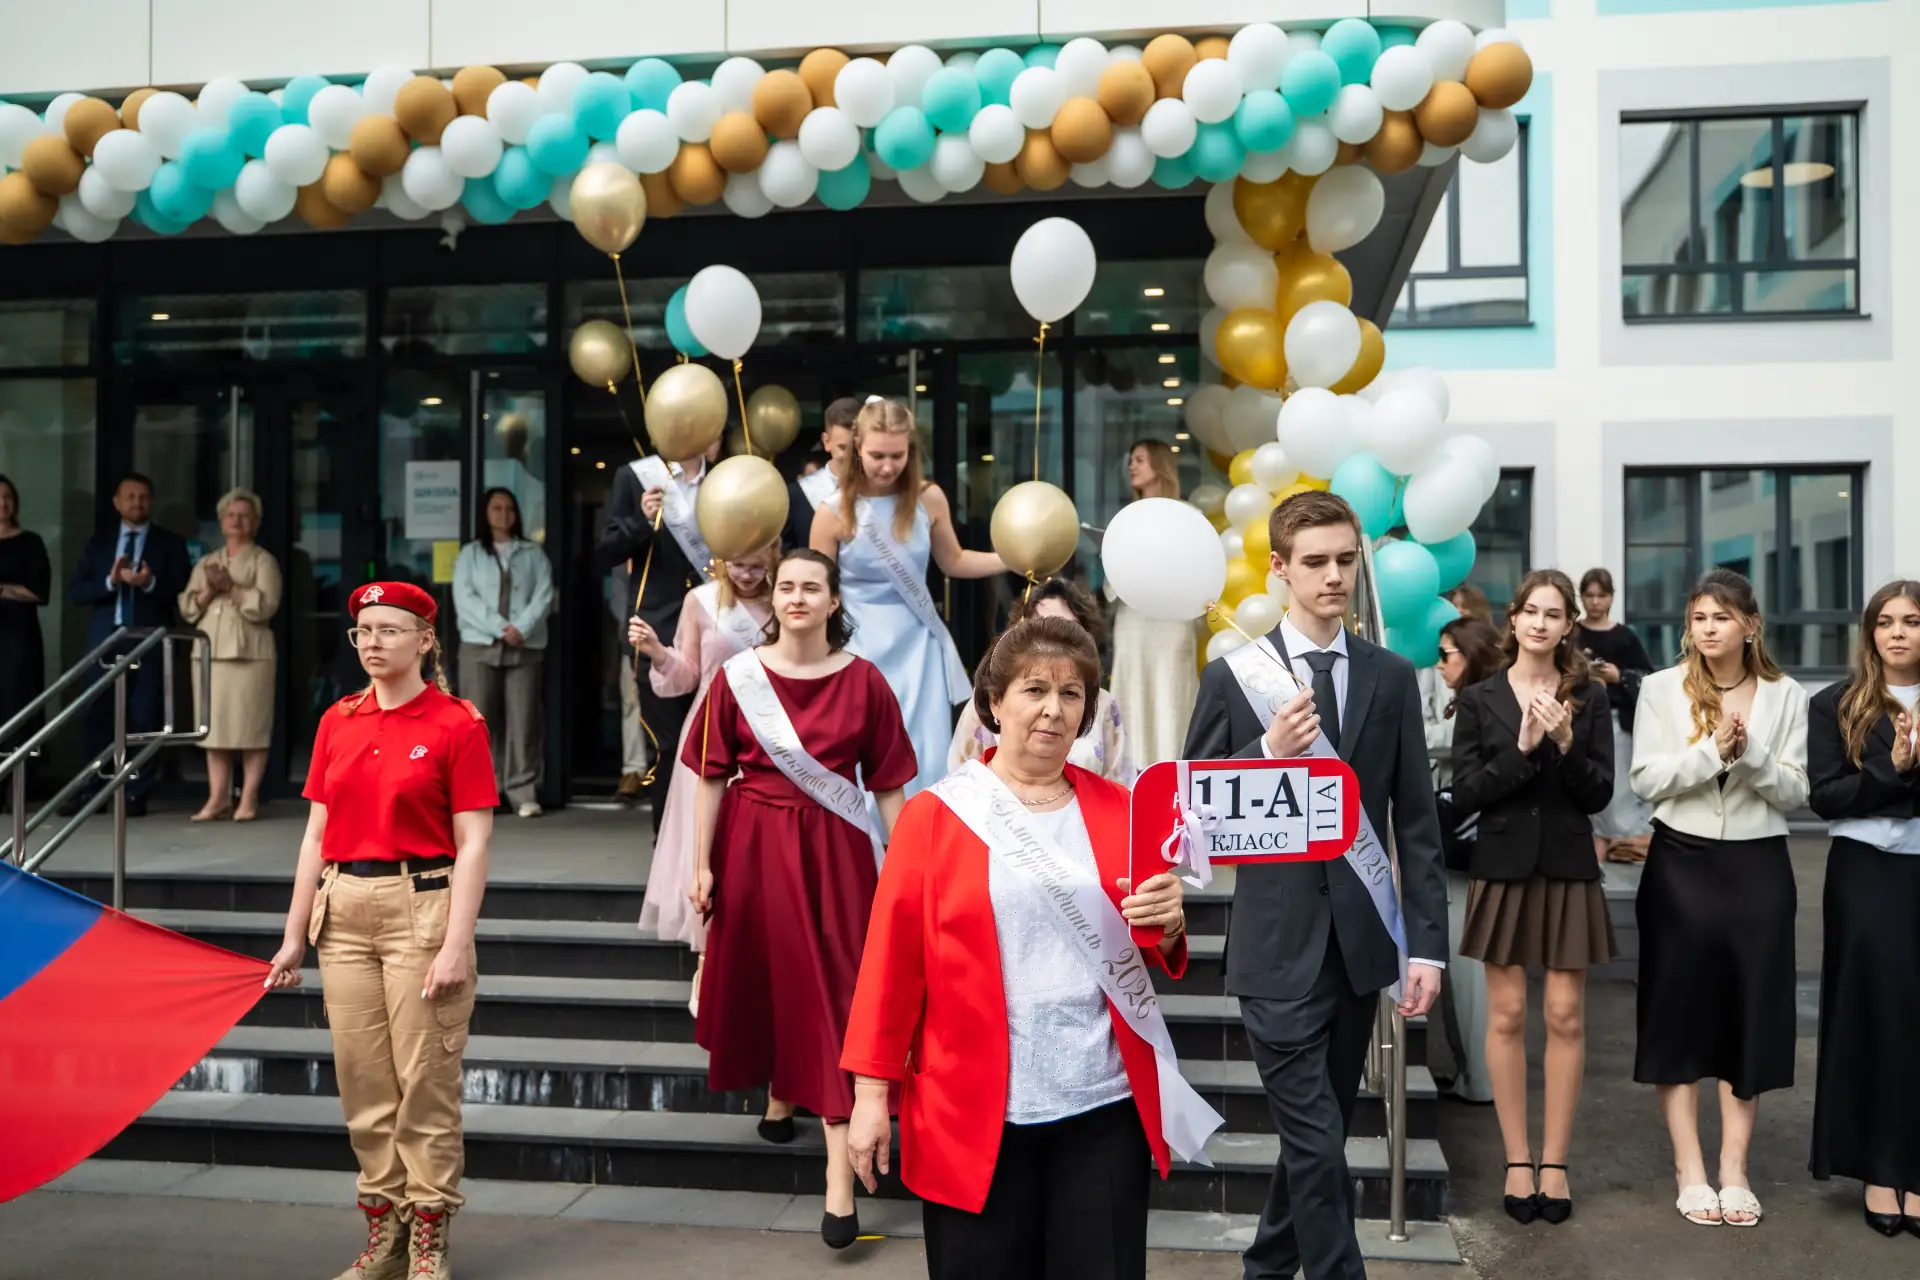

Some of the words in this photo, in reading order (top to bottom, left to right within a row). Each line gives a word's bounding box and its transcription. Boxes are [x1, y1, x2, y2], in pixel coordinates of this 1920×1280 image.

[990, 798, 1078, 882] Классный
[1209, 832, 1289, 853] КЛАСС
[1350, 828, 1389, 886] 2026
[1003, 847, 1102, 950] руководитель
[1102, 947, 1156, 1020] 2026
